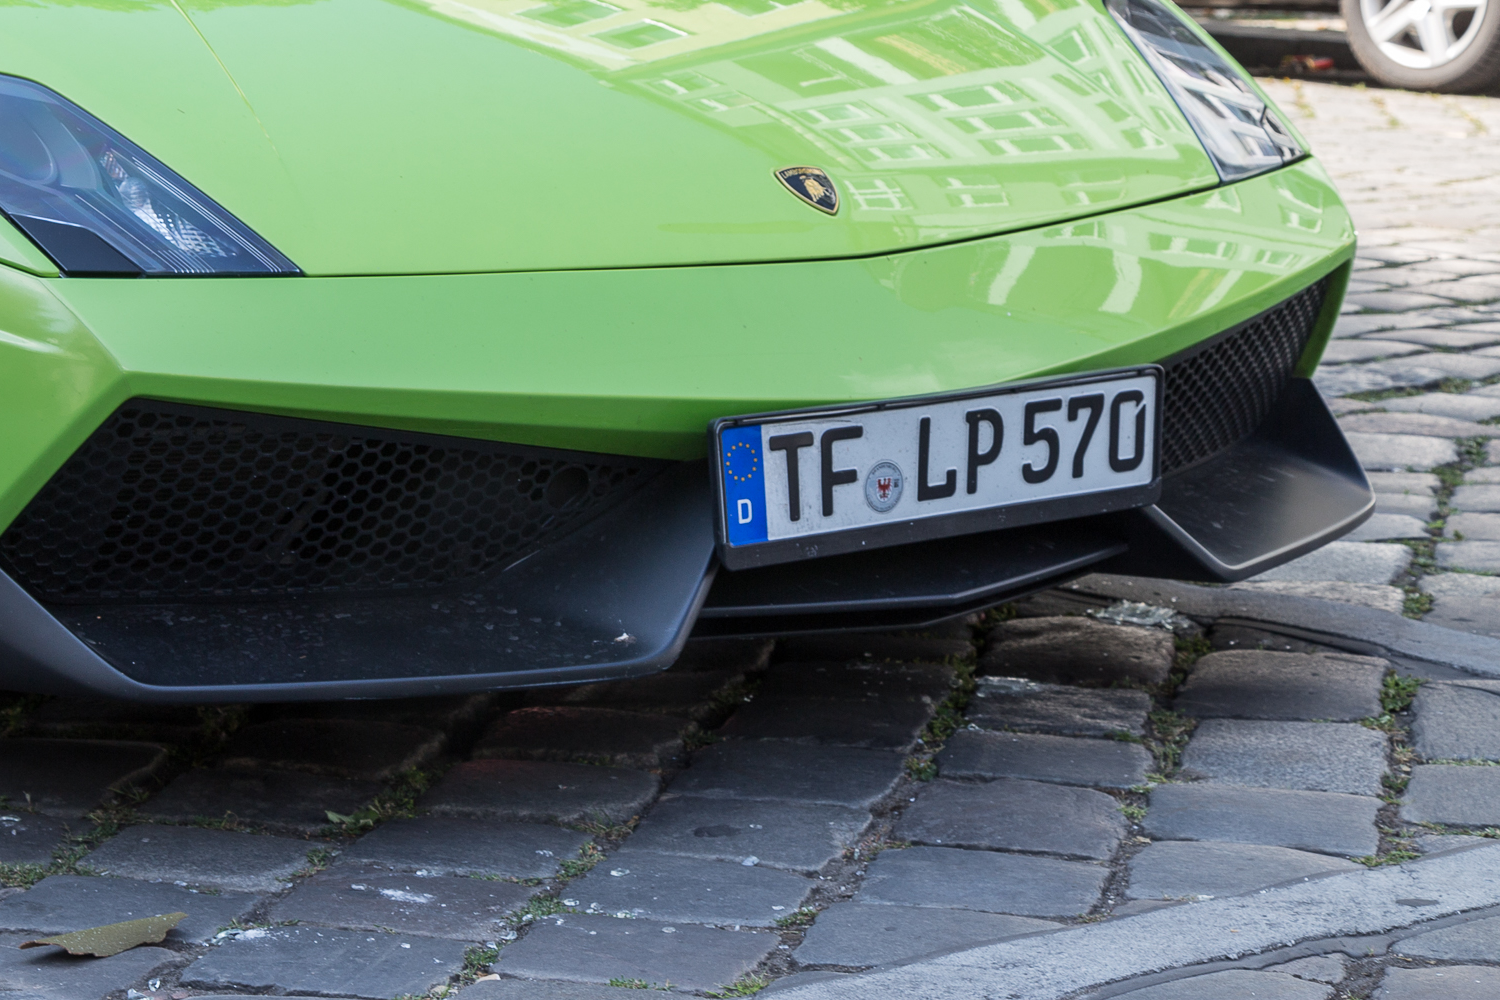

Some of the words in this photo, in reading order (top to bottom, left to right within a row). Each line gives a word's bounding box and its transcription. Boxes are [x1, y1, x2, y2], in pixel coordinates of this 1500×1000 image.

[769, 424, 863, 522] TF
[917, 407, 1004, 502] LP
[1021, 389, 1146, 485] 570
[737, 498, 753, 525] D
